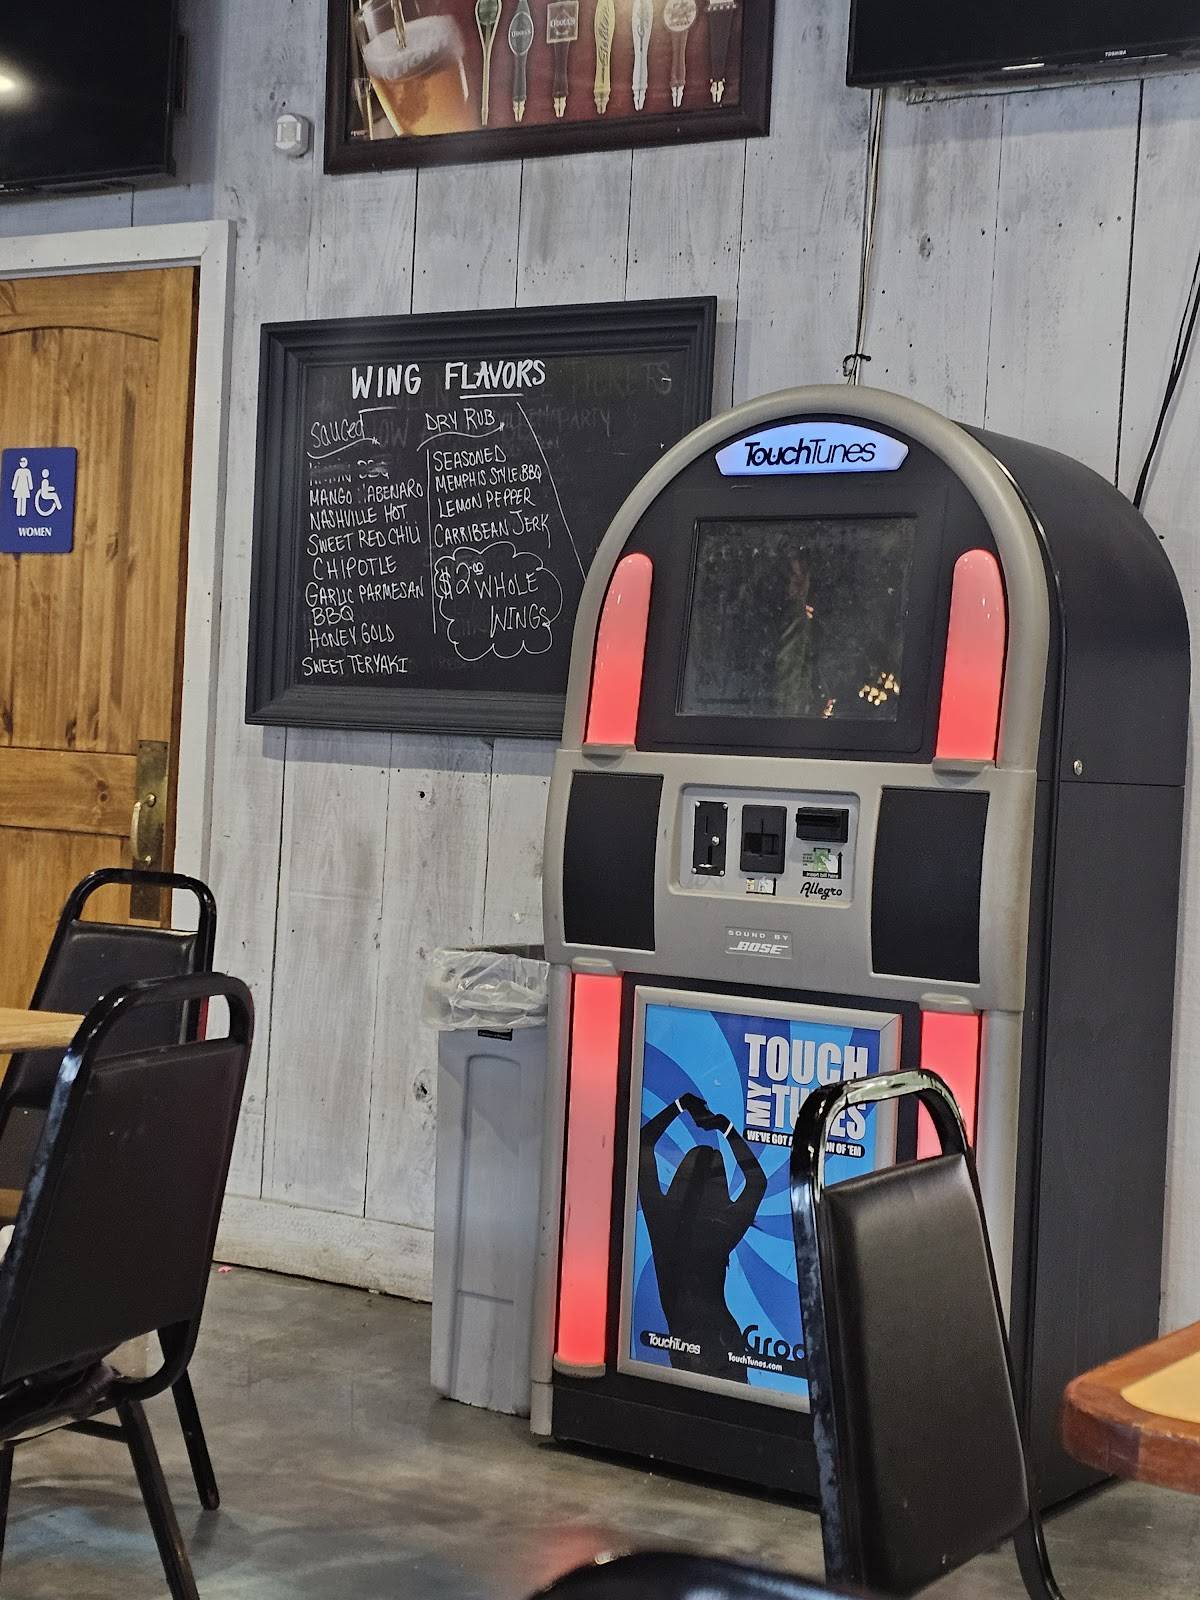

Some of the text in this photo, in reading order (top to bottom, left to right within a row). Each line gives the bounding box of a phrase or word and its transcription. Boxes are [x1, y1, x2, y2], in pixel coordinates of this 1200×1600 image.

[352, 360, 546, 399] WING FLAVORS
[425, 412, 458, 432] DRY
[464, 408, 495, 430] RUB
[433, 444, 507, 472] SEASONED
[744, 438, 877, 467] TouchTunes
[309, 478, 424, 506] MANGO ABENARO
[435, 464, 542, 494] MEMPHIS STYLE BBQ
[437, 487, 536, 518] LEMON PEPPER
[310, 503, 408, 531] NASHVILLE HOT
[434, 510, 551, 549] CARRIBEAN JERK
[18, 527, 52, 537] WOMEN
[307, 532, 354, 556] SWEET
[358, 529, 387, 548] RED
[313, 555, 397, 580] CHIPOTLE
[305, 576, 424, 607] GARLIC PARMESAN
[474, 571, 539, 599] WHOLE
[312, 605, 354, 626] BBQ
[489, 604, 551, 638] WINGS
[309, 622, 395, 653] HONEY GOLD
[302, 653, 409, 676] SWEET TERYAKI
[800, 881, 843, 900] Allegro
[728, 930, 766, 939] SOUND
[728, 941, 789, 954] BOSE
[744, 1033, 869, 1086] TOUCH
[746, 1079, 771, 1128] MY
[771, 1083, 866, 1140] TUES
[746, 1129, 771, 1143] WE'VE
[771, 1133, 788, 1146] GOT
[835, 1143, 847, 1154] OF
[649, 1333, 701, 1354] TouchTunes
[742, 1325, 808, 1362] Groo
[728, 1352, 783, 1372] TouchTunes.com
